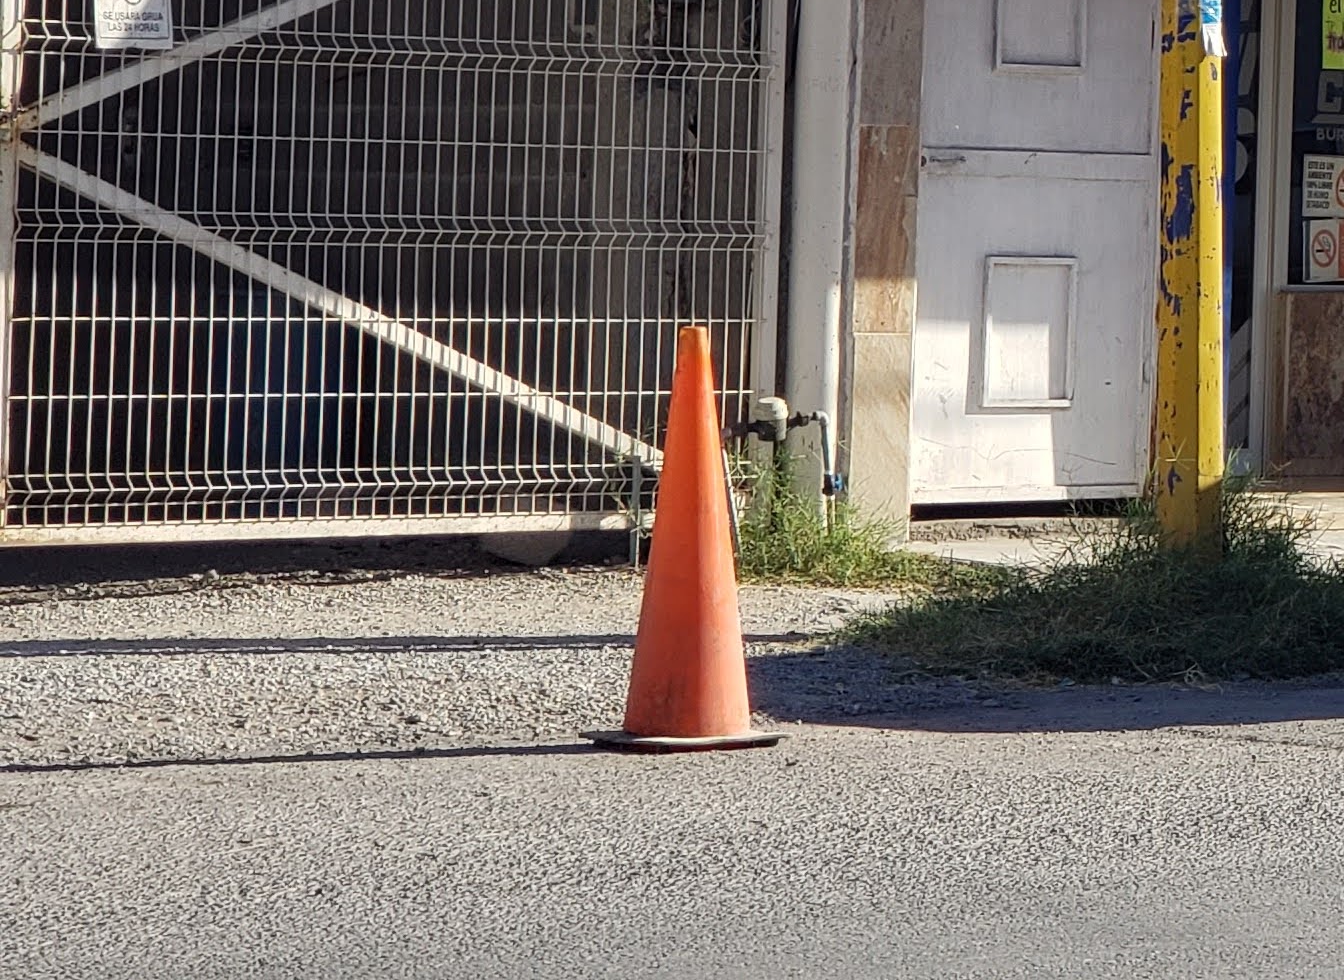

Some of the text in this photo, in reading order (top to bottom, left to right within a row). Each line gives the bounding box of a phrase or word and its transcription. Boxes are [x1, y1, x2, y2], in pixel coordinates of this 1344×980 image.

[103, 11, 113, 20] SE
[108, 22, 122, 31] LAS
[134, 23, 160, 32] HORAS
